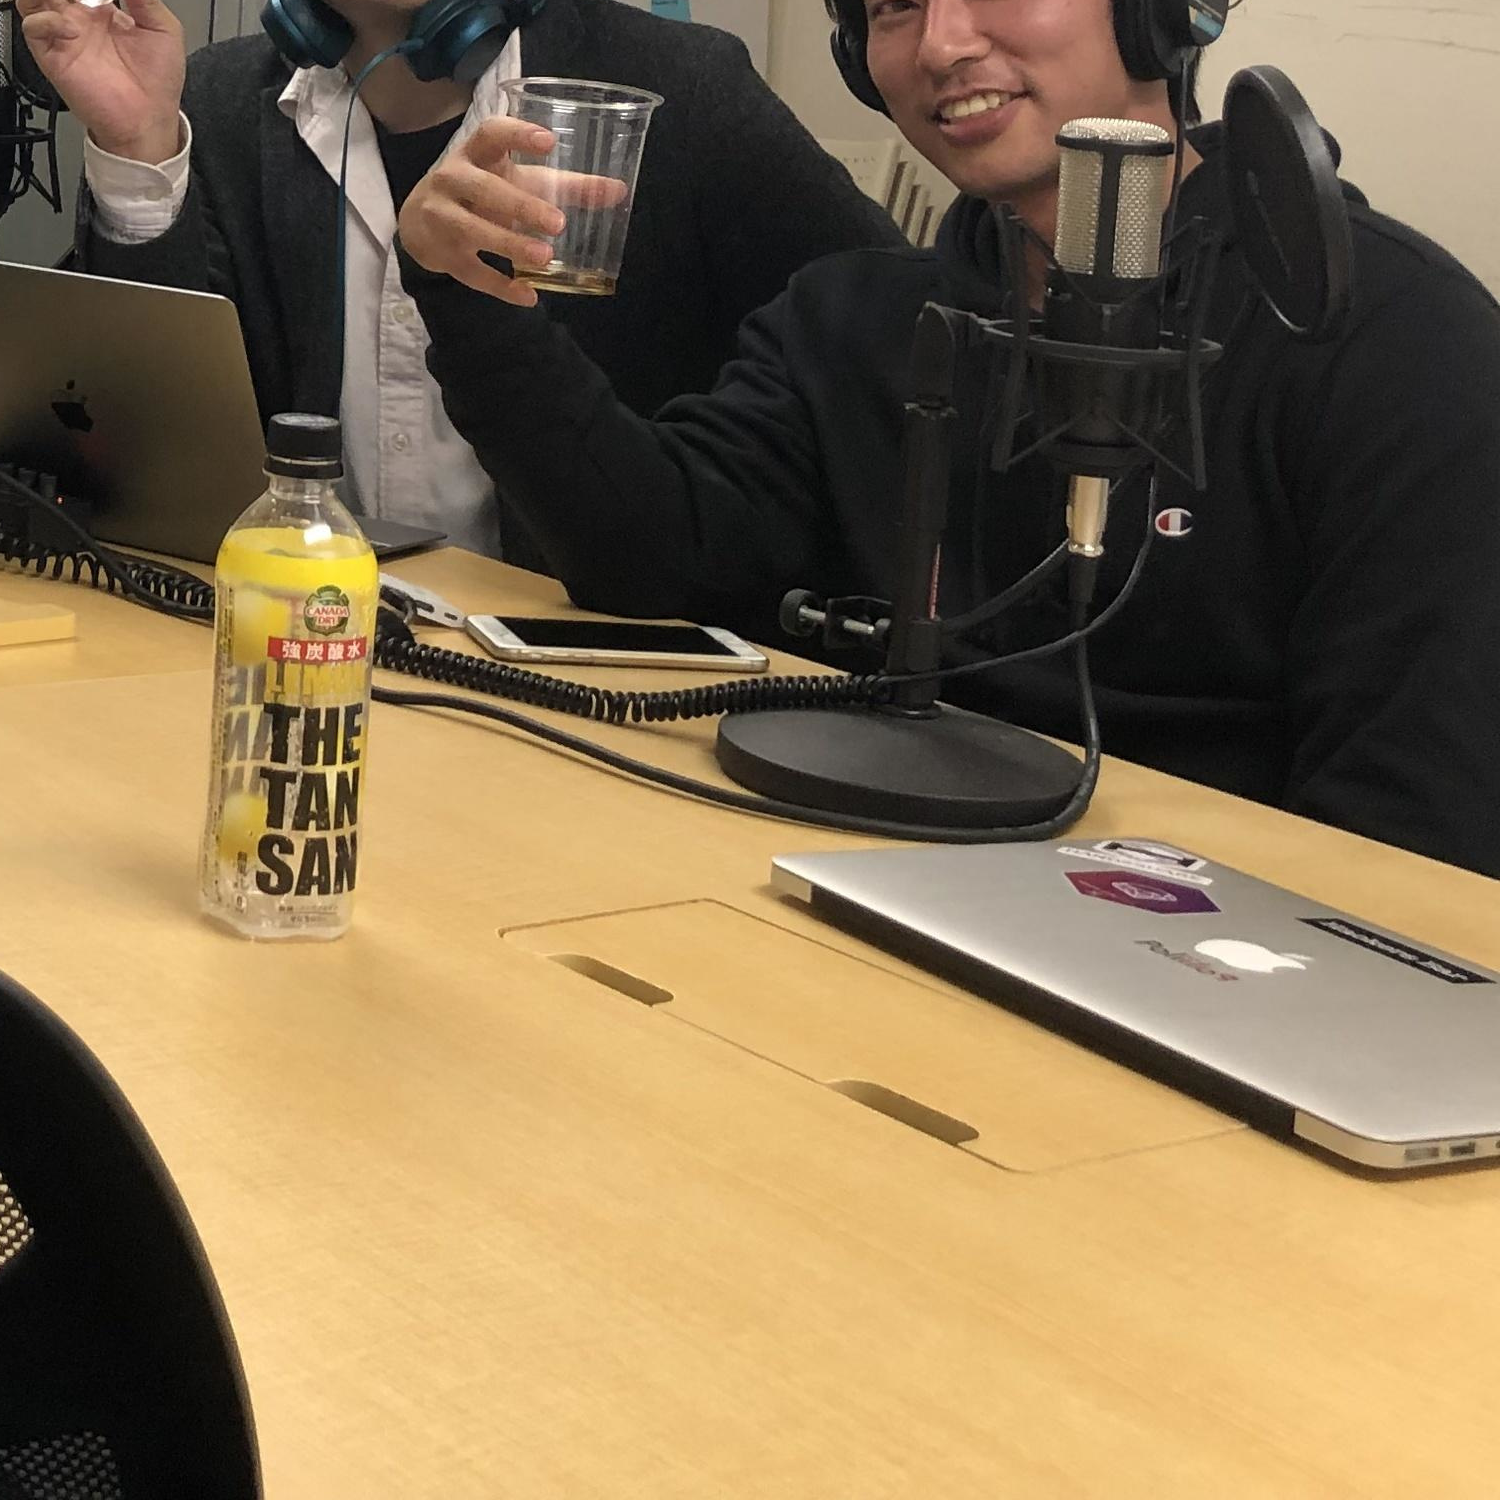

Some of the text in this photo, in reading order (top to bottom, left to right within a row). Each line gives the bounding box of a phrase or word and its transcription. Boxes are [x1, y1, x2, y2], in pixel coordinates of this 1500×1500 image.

[306, 606, 349, 616] CANADA
[317, 617, 336, 626] DRY
[282, 640, 361, 661] 強炭酸水
[262, 702, 363, 767] THE
[259, 766, 359, 833] TAN
[256, 830, 357, 897] SAN
